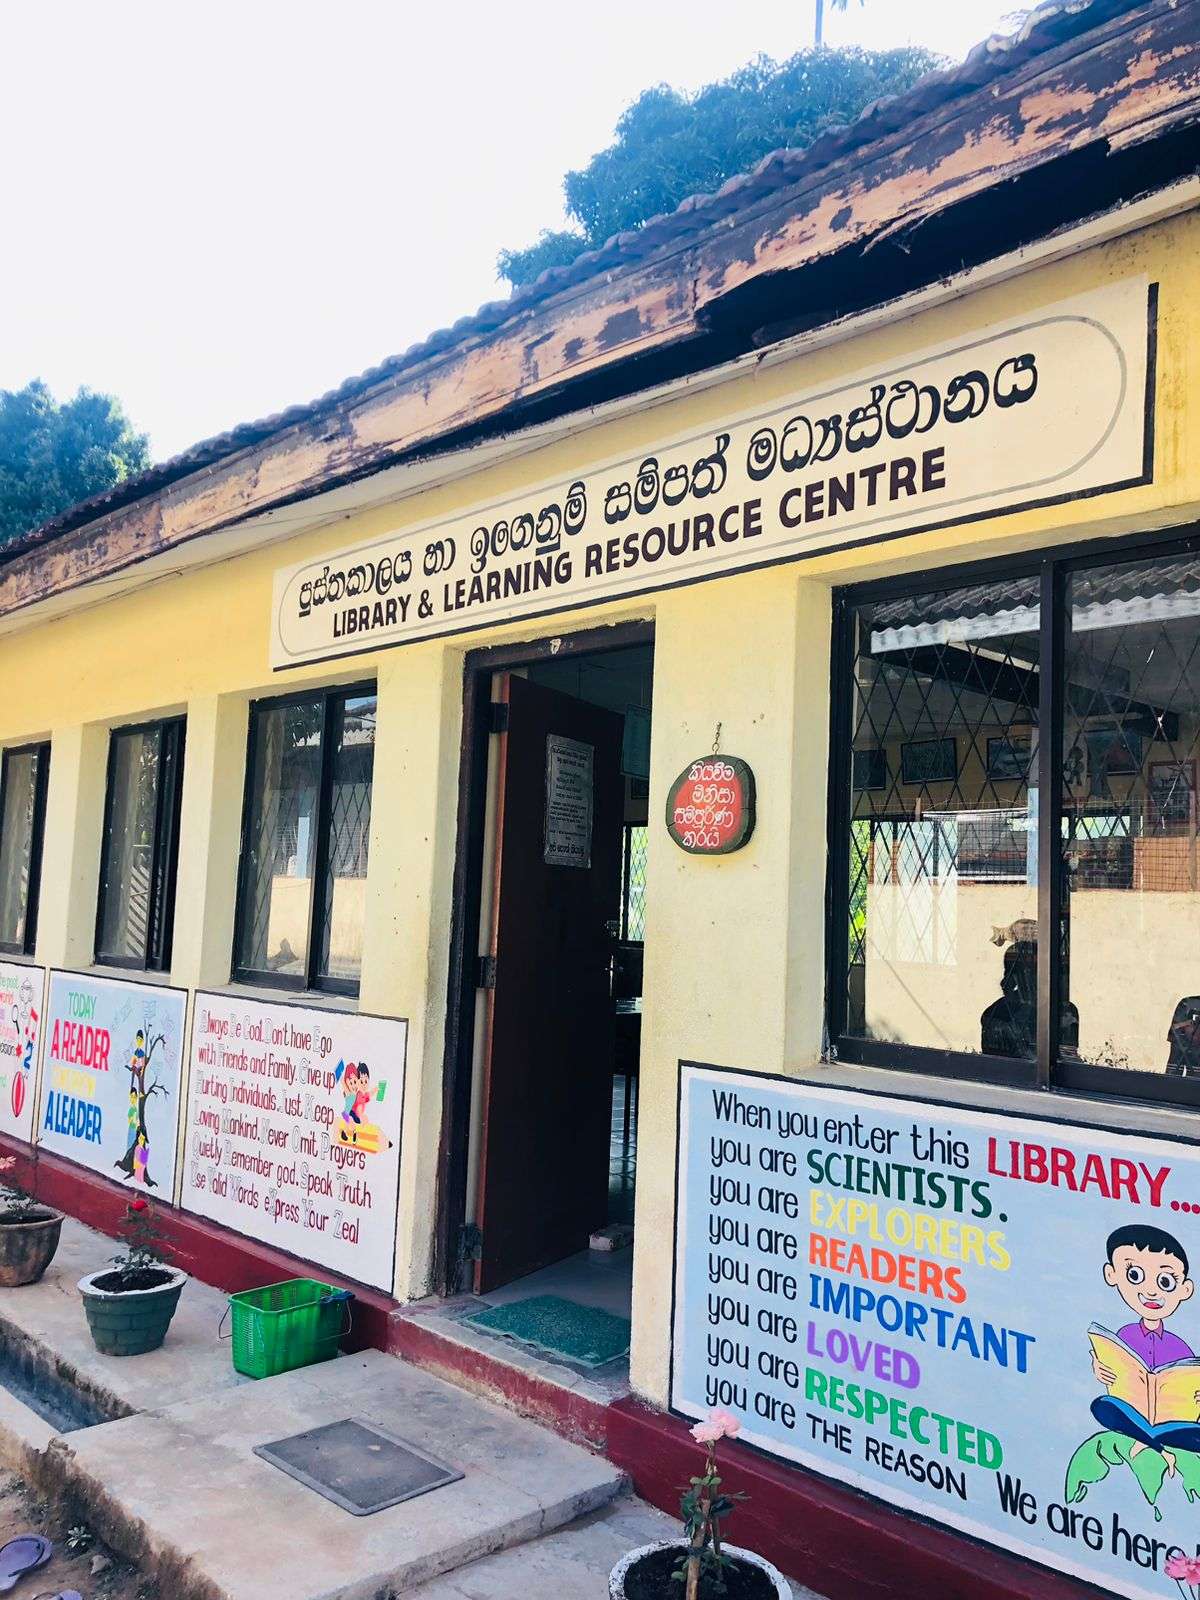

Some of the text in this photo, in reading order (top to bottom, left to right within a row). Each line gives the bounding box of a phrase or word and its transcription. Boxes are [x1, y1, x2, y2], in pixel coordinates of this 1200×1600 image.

[423, 537, 456, 576] හා
[604, 433, 731, 524] සම්පත්
[333, 446, 946, 638] LIBRARY & LEARNING RESOURCE CENTRE
[68, 991, 97, 1019] TODAY
[50, 1018, 111, 1071] A READER
[198, 1043, 216, 1066] with
[217, 1043, 248, 1071] Friends
[250, 1053, 266, 1075] and
[323, 1073, 335, 1095] up
[291, 1024, 311, 1050] have
[313, 1025, 332, 1058] Ego
[44, 1090, 102, 1145] A LEADER
[194, 1100, 219, 1135] Loving
[292, 1125, 318, 1157] Omit
[321, 1132, 366, 1170] Prayers
[305, 1093, 334, 1130] Keep
[712, 1090, 772, 1130] When
[777, 1108, 819, 1138] you
[823, 1114, 899, 1152] enter
[910, 1124, 969, 1169] this
[224, 1140, 273, 1178] Remember
[277, 1161, 298, 1188] god.
[300, 1161, 332, 1197] Speak
[336, 1172, 371, 1208] Truth
[711, 1136, 752, 1168] you
[759, 1147, 797, 1177] are
[302, 1198, 329, 1231] Your
[333, 1209, 359, 1244] Zeal
[710, 1174, 1011, 1272] you are EXPLORERS
[709, 1213, 967, 1304] you are READERS
[708, 1252, 1036, 1374] you are IMPORTANT
[708, 1292, 920, 1389] you are LOVED
[707, 1332, 1003, 1471] you are RESPECTED
[705, 1374, 750, 1407] you
[754, 1394, 796, 1429] are
[805, 1413, 852, 1454] THE
[865, 1437, 967, 1501] REASON
[996, 1471, 1037, 1524] We
[1047, 1501, 1103, 1551] are
